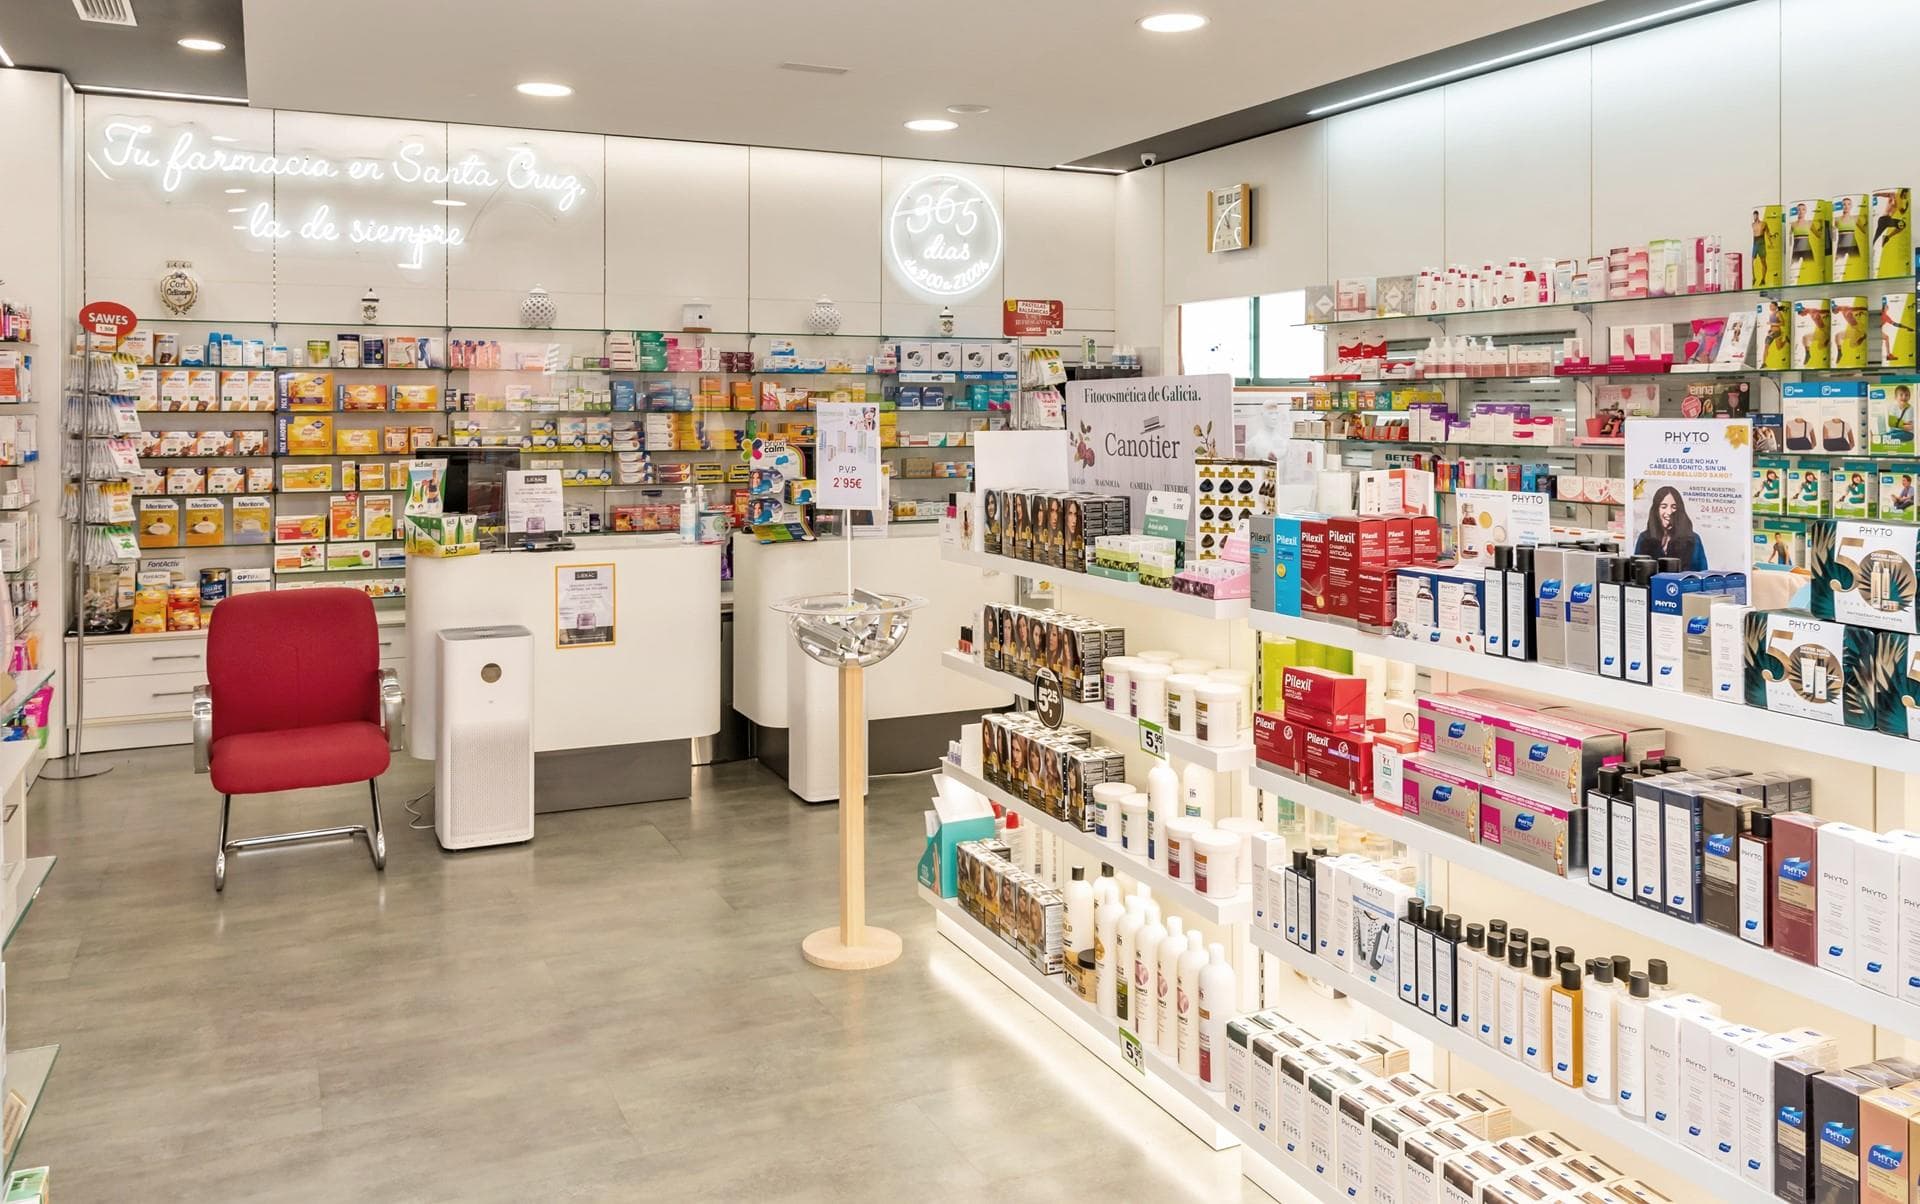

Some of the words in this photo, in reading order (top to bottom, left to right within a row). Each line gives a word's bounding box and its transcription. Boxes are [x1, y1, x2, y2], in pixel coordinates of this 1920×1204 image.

[104, 122, 160, 168] Tu
[162, 133, 338, 192] farmacia
[349, 160, 384, 181] en
[392, 143, 498, 188] Santa
[507, 148, 587, 212] Cruz,
[905, 185, 980, 235] 365
[247, 202, 288, 240] la
[300, 204, 336, 241] de
[350, 219, 465, 269] siempre
[88, 312, 129, 325] SAWES
[1084, 386, 1148, 404] Fitocosmética
[1148, 389, 1160, 402] de
[1162, 386, 1202, 402] Galicia.
[1664, 432, 1710, 442] PHYTO
[764, 445, 785, 454] calm
[1105, 432, 1180, 459] Canotier
[1385, 454, 1414, 462] BETE
[1095, 480, 1120, 489] MAGNOLIA
[1130, 482, 1153, 492] CAMELIA
[1512, 494, 1544, 506] PHYTO
[1712, 506, 1736, 514] MAYO
[1250, 532, 1271, 543] Pilexil
[1302, 532, 1324, 543] Pilexil
[1329, 530, 1356, 544] Pilexil
[1859, 526, 1893, 537] PHYTO
[1276, 534, 1298, 546] Pilexil
[147, 560, 180, 568] FontActiv
[1542, 586, 1560, 594] PHYTO
[1655, 600, 1677, 608] PHYTO
[1690, 622, 1706, 631] PHYTO
[1788, 620, 1821, 632] PHYTO
[1284, 674, 1313, 692] Pilexil
[1255, 716, 1276, 731] Pilexil
[1306, 732, 1330, 747] Pilexil
[1437, 735, 1482, 754] PHYTOCYANE
[1517, 758, 1566, 778] PHYTOCYANE
[1421, 799, 1465, 818] PHYTOCYANE
[1612, 812, 1632, 824] PHYTO
[1503, 826, 1552, 850] PHYTOCYANE
[1708, 841, 1730, 852] PHYTO
[1742, 850, 1762, 861] PHYTO
[1784, 864, 1808, 878] PHYTO
[1824, 872, 1849, 886] PHYTO
[1363, 883, 1383, 896] PHYTO
[1862, 886, 1888, 900] PHYTO
[1904, 898, 1920, 908] PHY
[1228, 1043, 1246, 1058] PHYTO
[1650, 1044, 1671, 1058] PHYTO
[1254, 1060, 1272, 1076] PHYTO
[1685, 1058, 1707, 1072] PHYTO
[1282, 1078, 1301, 1094] PHYTO
[1713, 1072, 1736, 1088] PHYTO
[1742, 1087, 1765, 1103] PHYTO
[1311, 1099, 1330, 1116] PHYTO
[1782, 1110, 1801, 1124] PHYTO
[1342, 1118, 1362, 1136] PHYTO
[1826, 1128, 1851, 1144] PHYTO
[1374, 1140, 1396, 1159] PHYTO
[1873, 1150, 1900, 1166] PHYTO
[1408, 1164, 1430, 1184] PHYTO
[1446, 1187, 1470, 1204] PHYTO
